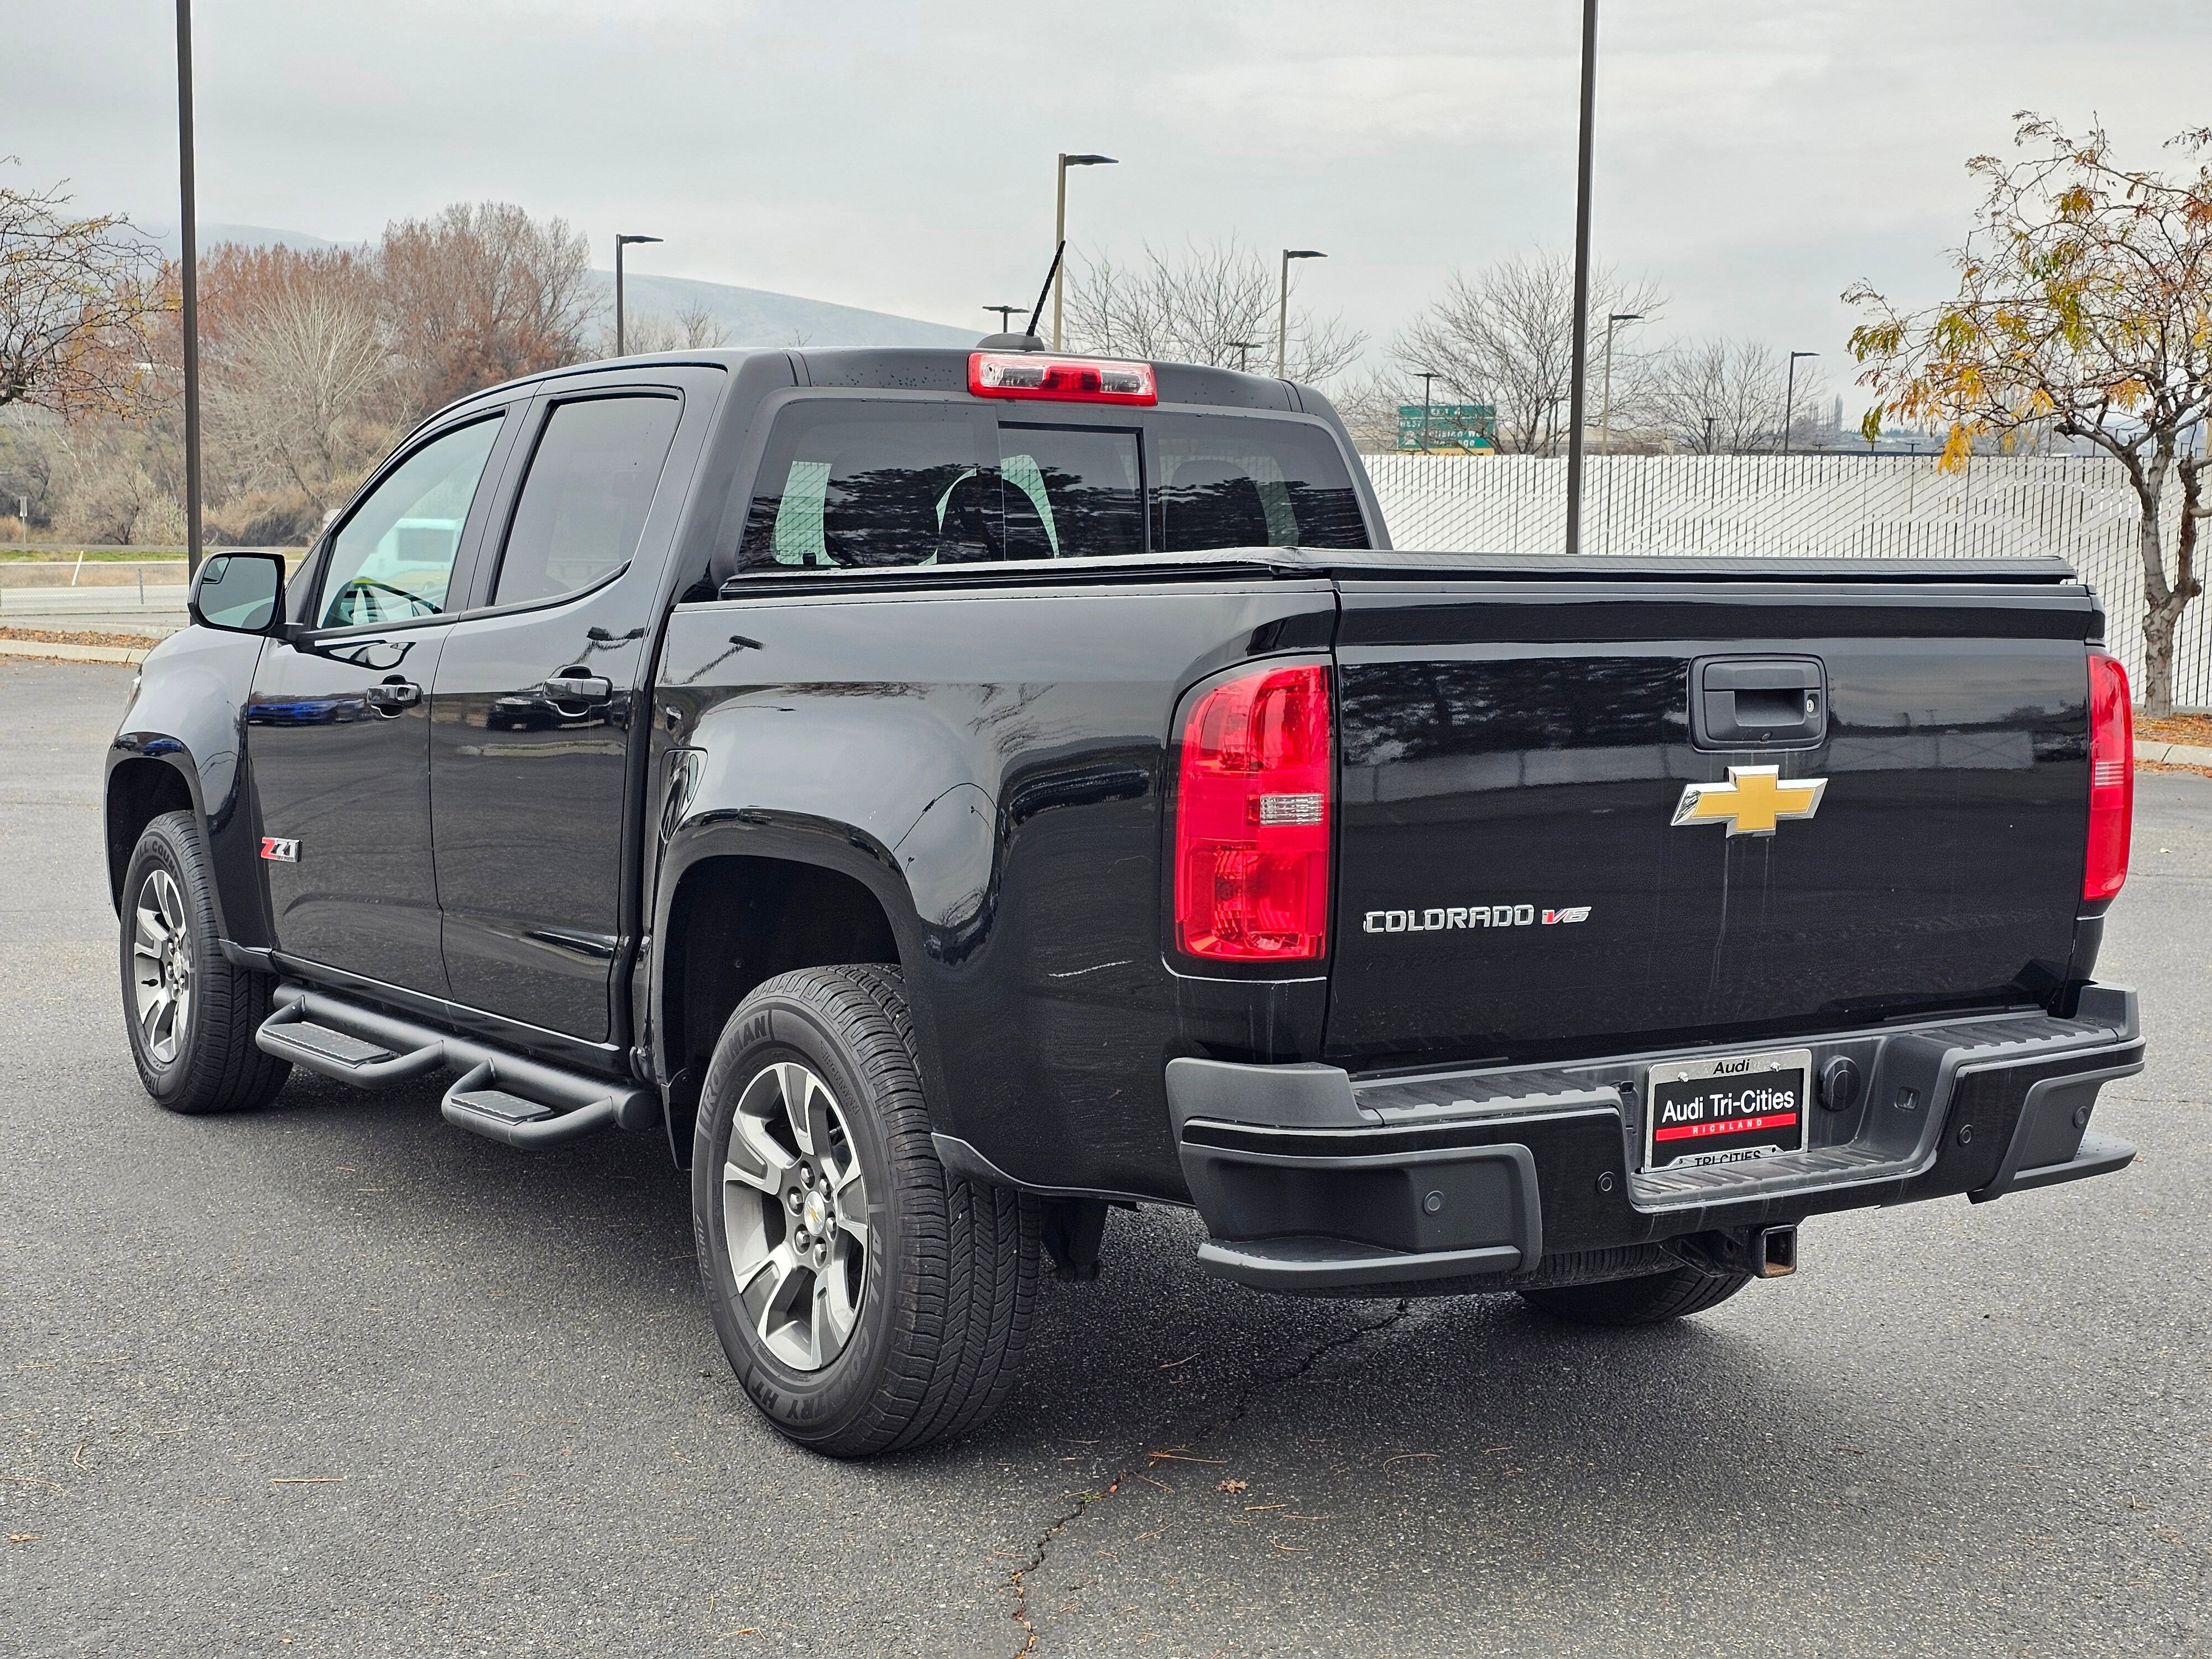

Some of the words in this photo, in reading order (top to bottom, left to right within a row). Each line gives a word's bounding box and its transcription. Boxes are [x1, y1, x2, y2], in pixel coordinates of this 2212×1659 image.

[261, 837, 299, 862] Z71
[1363, 904, 1534, 933] COLORADO
[1541, 906, 1592, 925] V6
[1713, 1059, 1750, 1074] Audi
[822, 1052, 861, 1115] IRONMAN
[1662, 1096, 1703, 1123] Audi
[1709, 1088, 1794, 1117] Tri-Cities
[1693, 1119, 1762, 1134] RICHLAND
[868, 1222, 882, 1306] ALL
[751, 1381, 780, 1410] HT
